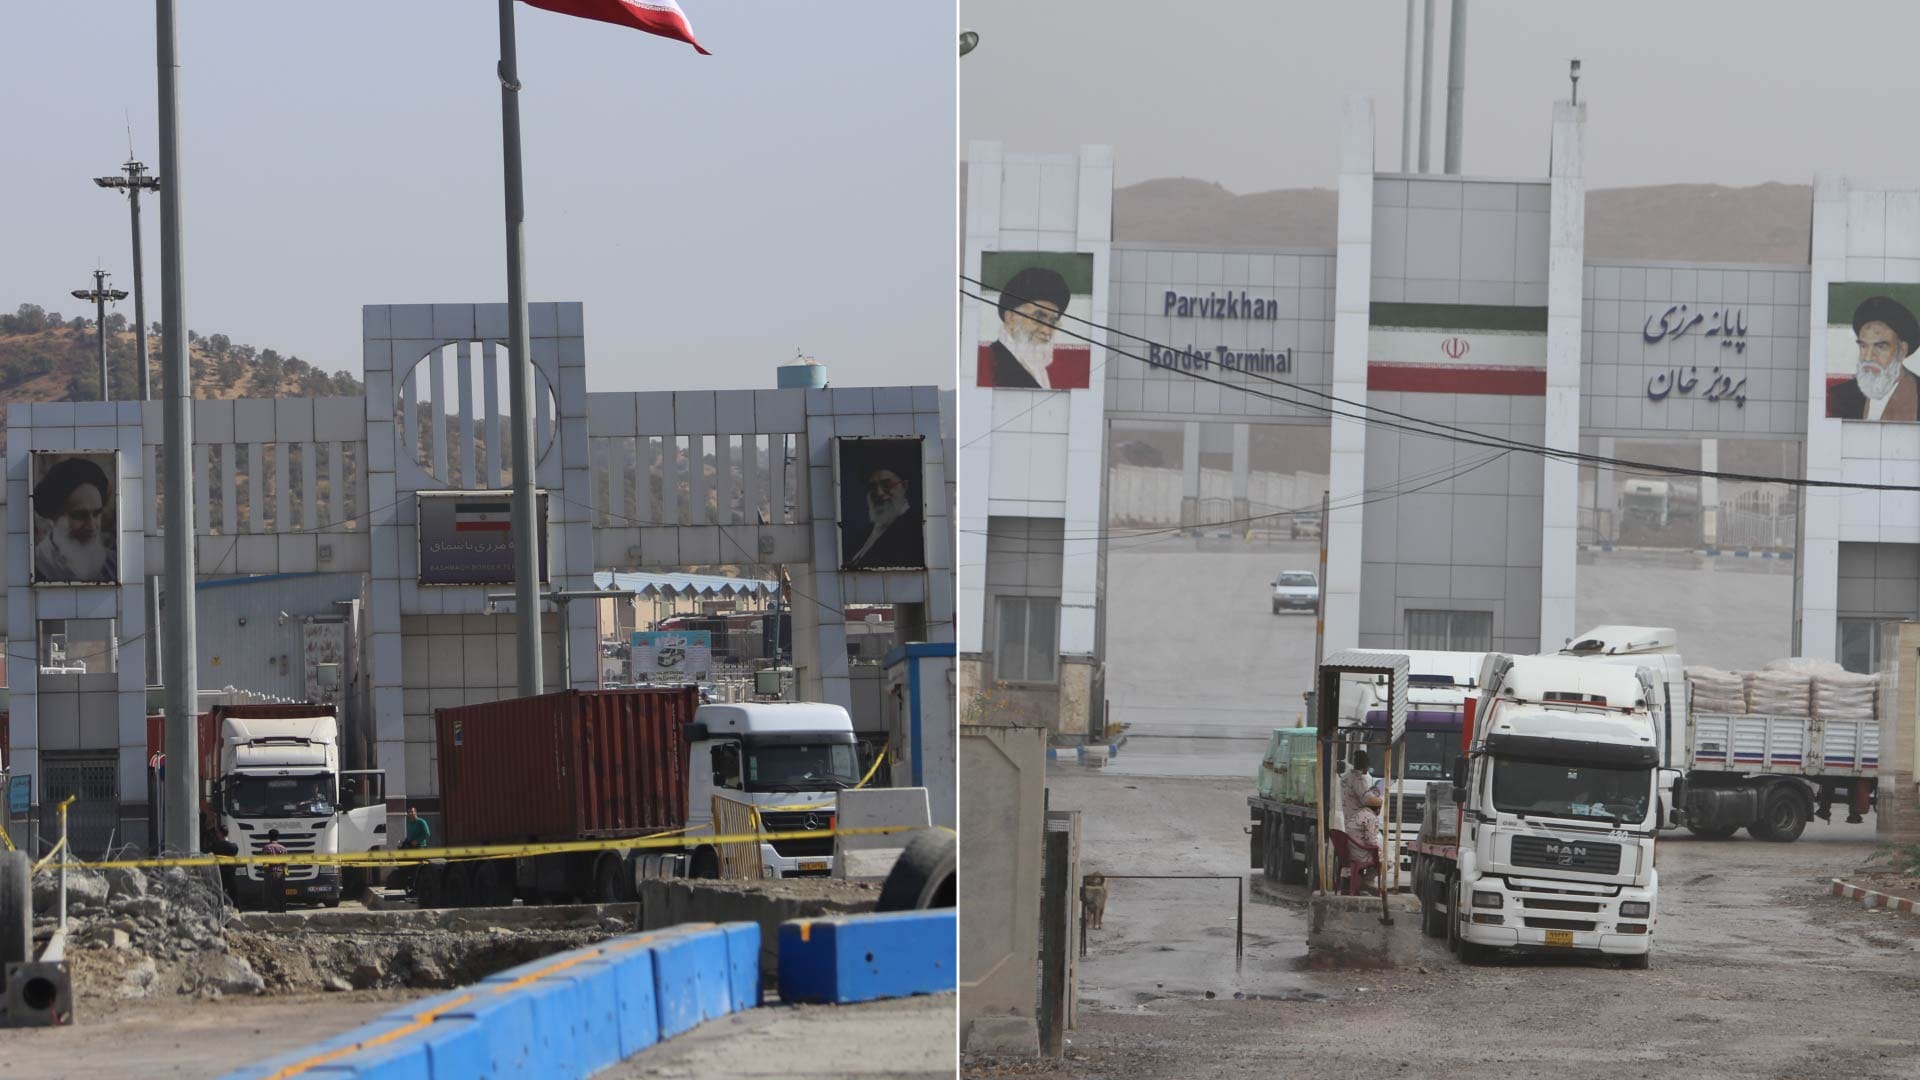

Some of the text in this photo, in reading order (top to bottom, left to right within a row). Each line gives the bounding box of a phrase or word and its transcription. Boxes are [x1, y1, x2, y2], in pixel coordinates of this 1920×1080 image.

[1164, 290, 1278, 321] Parvizkhan
[1643, 304, 1747, 354] پایانه مرزی
[1150, 343, 1291, 373] Border Terminal
[1647, 366, 1747, 408] پرویز خان
[1546, 844, 1587, 856] MAN
